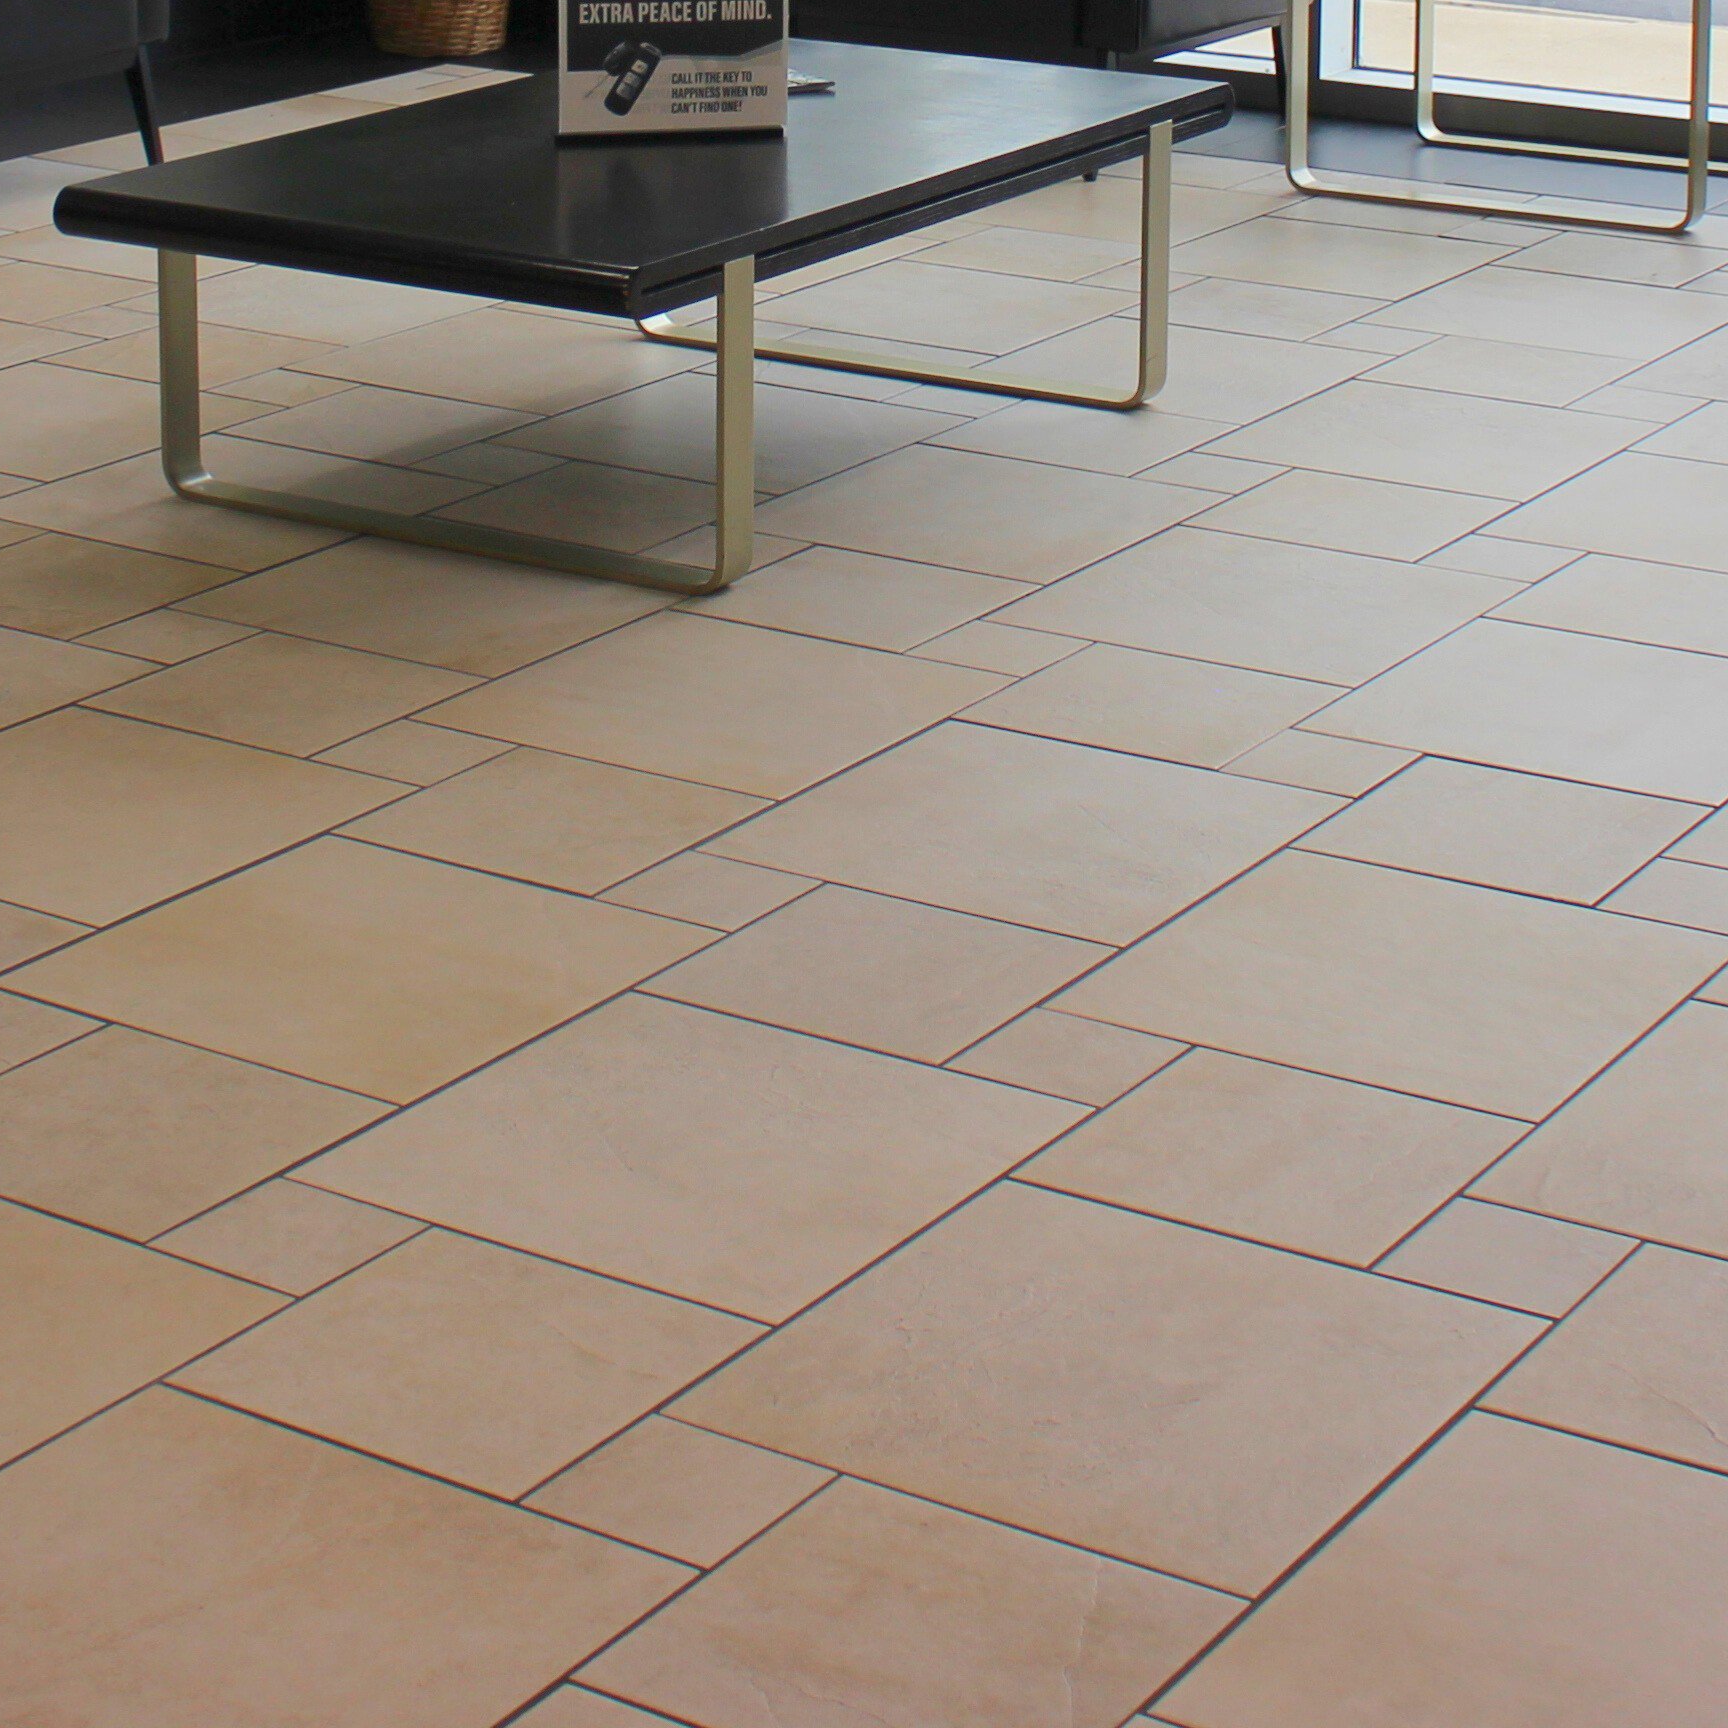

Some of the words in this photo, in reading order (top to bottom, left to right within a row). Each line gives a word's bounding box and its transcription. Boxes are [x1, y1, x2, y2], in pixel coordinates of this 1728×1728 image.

[579, 3, 634, 25] EXTRA
[638, 2, 692, 23] PEACE
[696, 1, 718, 22] OF
[722, 0, 772, 21] MIND.
[672, 72, 691, 84] CALL
[695, 72, 703, 83] IT
[704, 71, 720, 83] THE
[723, 71, 739, 82] KEY
[741, 71, 752, 82] TO
[672, 86, 721, 99] HAPPINESS
[722, 85, 748, 97] WHEN
[750, 84, 768, 96] YOU
[671, 101, 697, 114] CAN'T
[699, 100, 720, 112] FIND
[721, 99, 742, 112] ONE!
